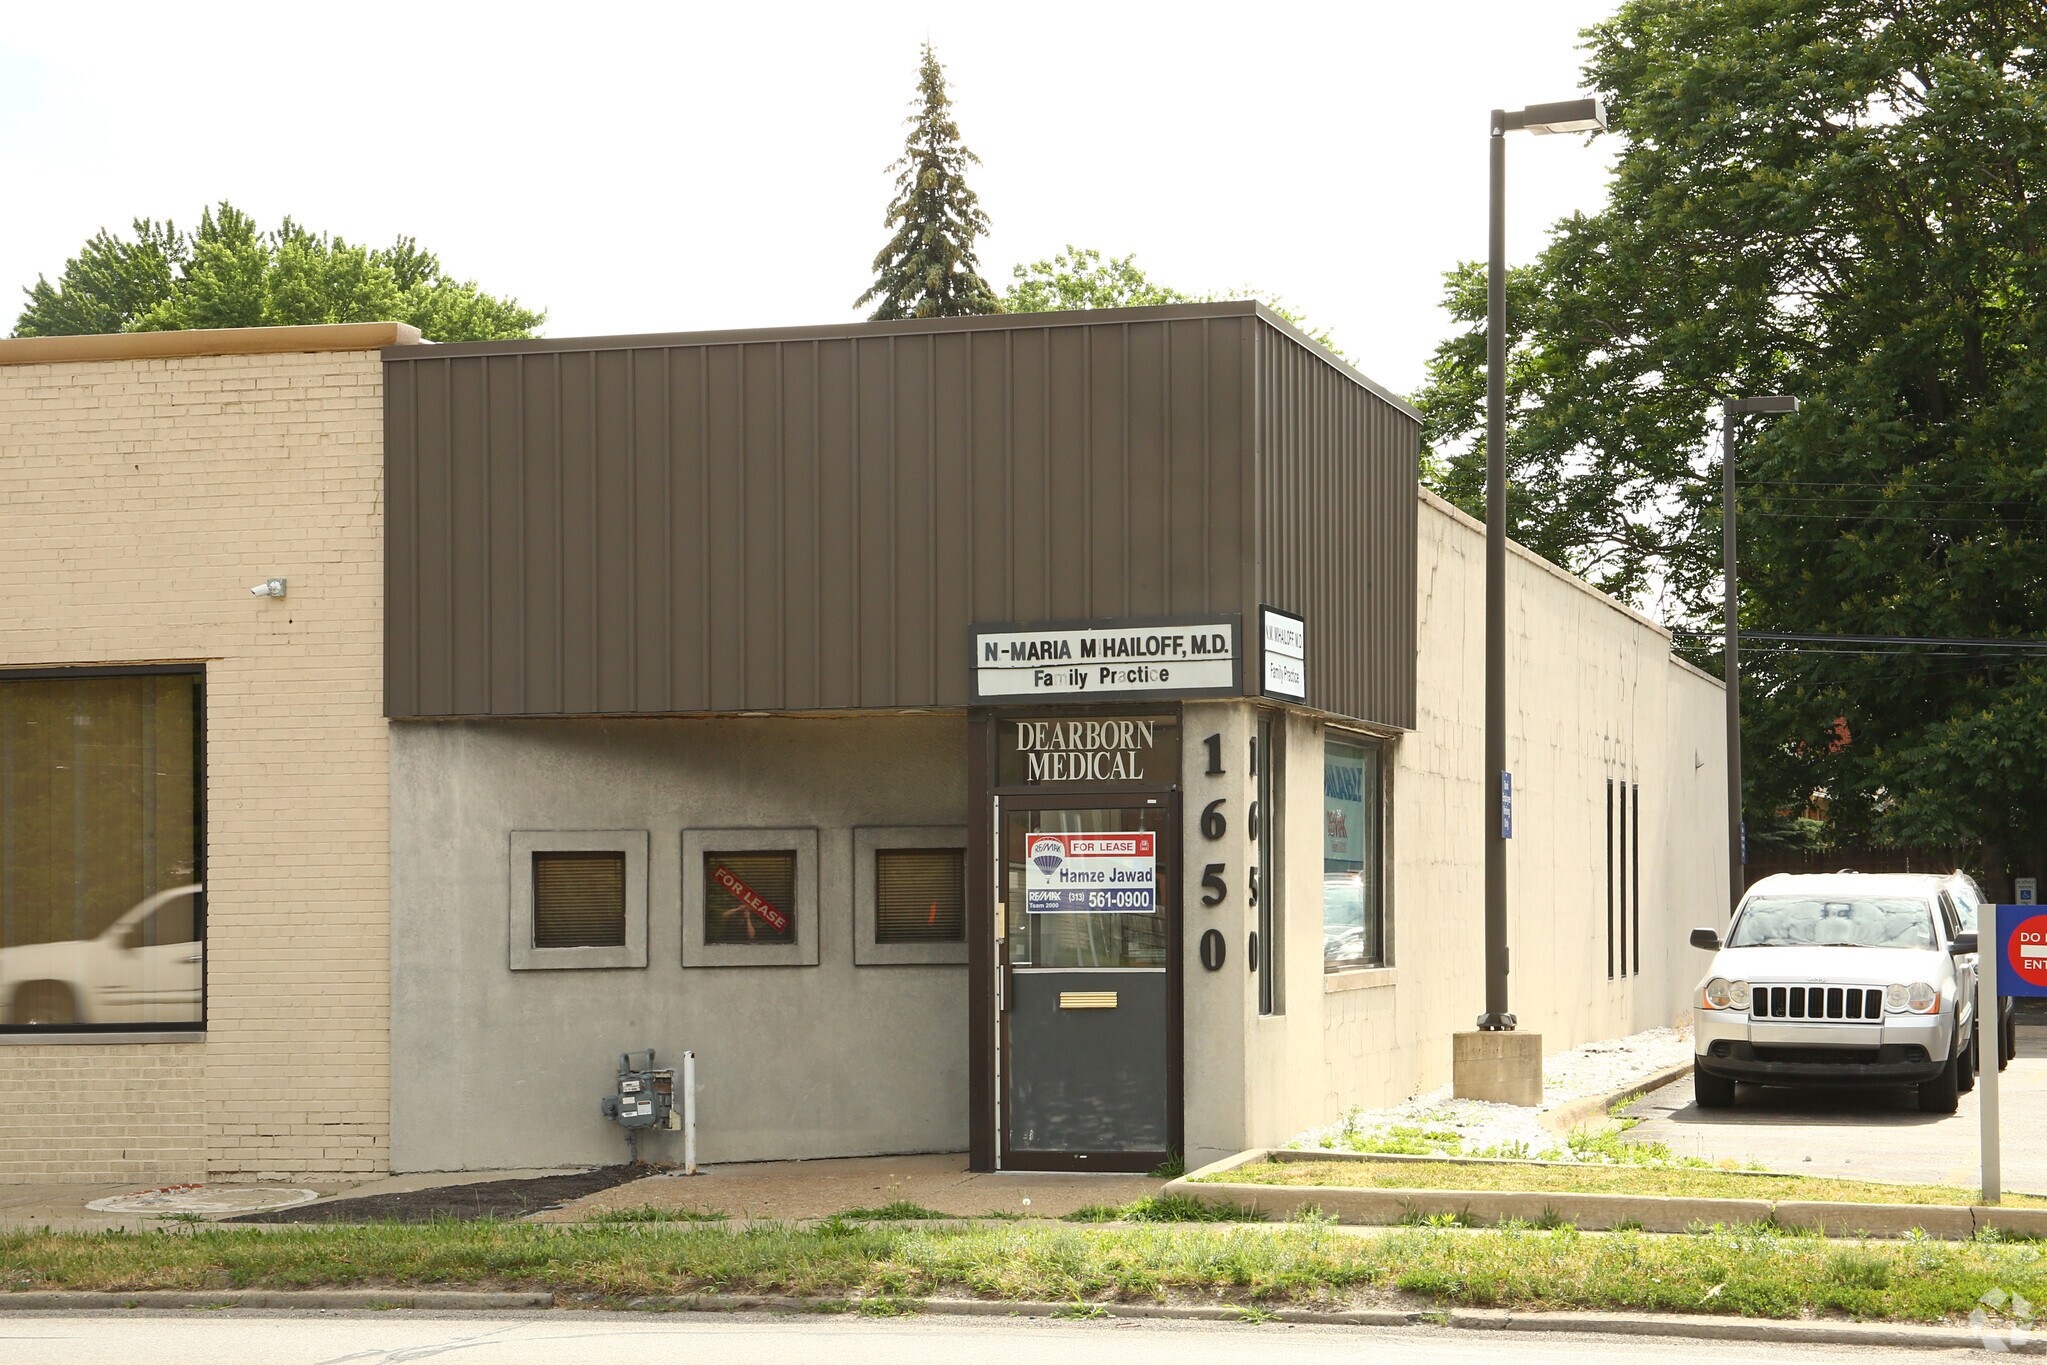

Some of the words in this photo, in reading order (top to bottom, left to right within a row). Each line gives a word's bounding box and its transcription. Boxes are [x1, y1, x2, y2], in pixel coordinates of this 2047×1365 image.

[1080, 635, 1187, 659] MIHAILOFF,
[1190, 633, 1229, 655] M.D.
[1034, 669, 1088, 689] Family
[1099, 666, 1170, 685] Practice
[1016, 720, 1155, 752] DEARBORN
[1026, 751, 1144, 781] MEDICAL
[1034, 843, 1062, 852] RE/MAX
[1073, 842, 1095, 852] FOR
[1099, 842, 1134, 851] LEASE
[1059, 868, 1105, 883] Hamze
[1109, 867, 1153, 883] Jawad
[714, 868, 744, 895] FOR
[743, 892, 786, 929] LEASE
[1029, 891, 1062, 902] RE/MAX
[1068, 891, 1085, 903] (313)
[1088, 891, 1150, 908] 561-0900
[2020, 932, 2041, 943] DO
